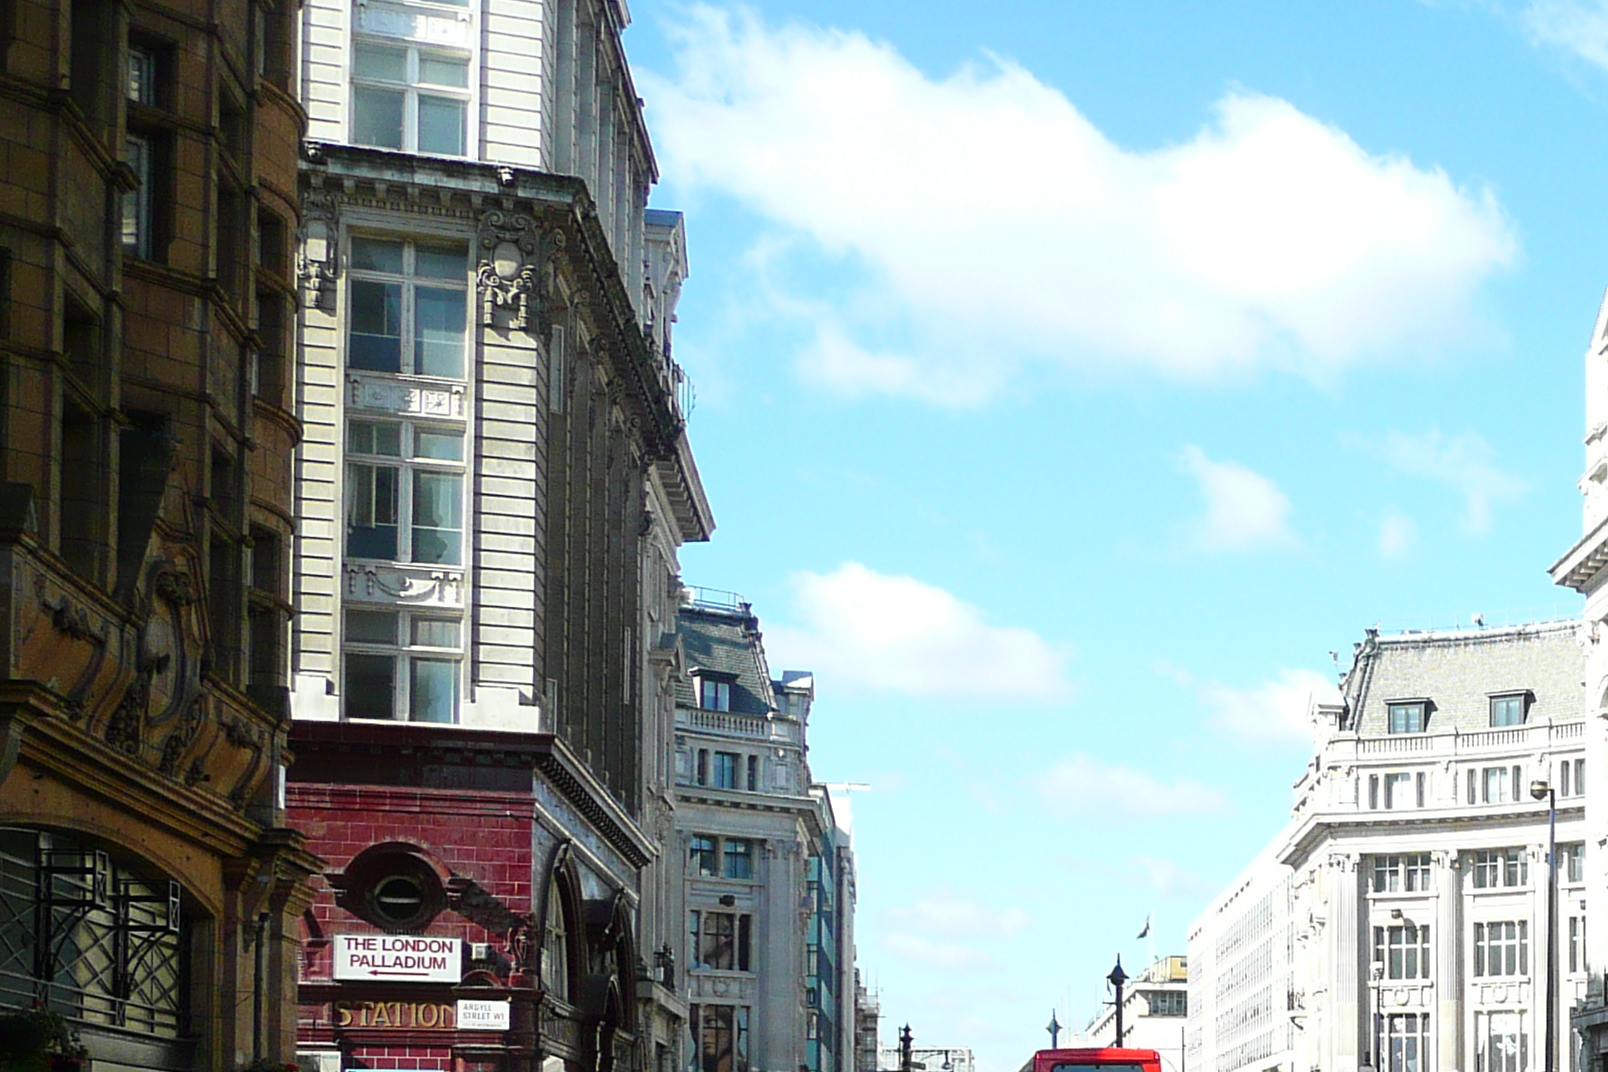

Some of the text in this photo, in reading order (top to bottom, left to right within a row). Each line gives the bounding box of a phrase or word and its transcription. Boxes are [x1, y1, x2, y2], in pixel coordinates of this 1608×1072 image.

[344, 937, 453, 954] THE LONDON
[350, 954, 447, 970] PALLADIUM
[334, 1001, 457, 1029] STATION
[463, 1003, 492, 1011] ARGYLL
[463, 1012, 490, 1020] STREET
